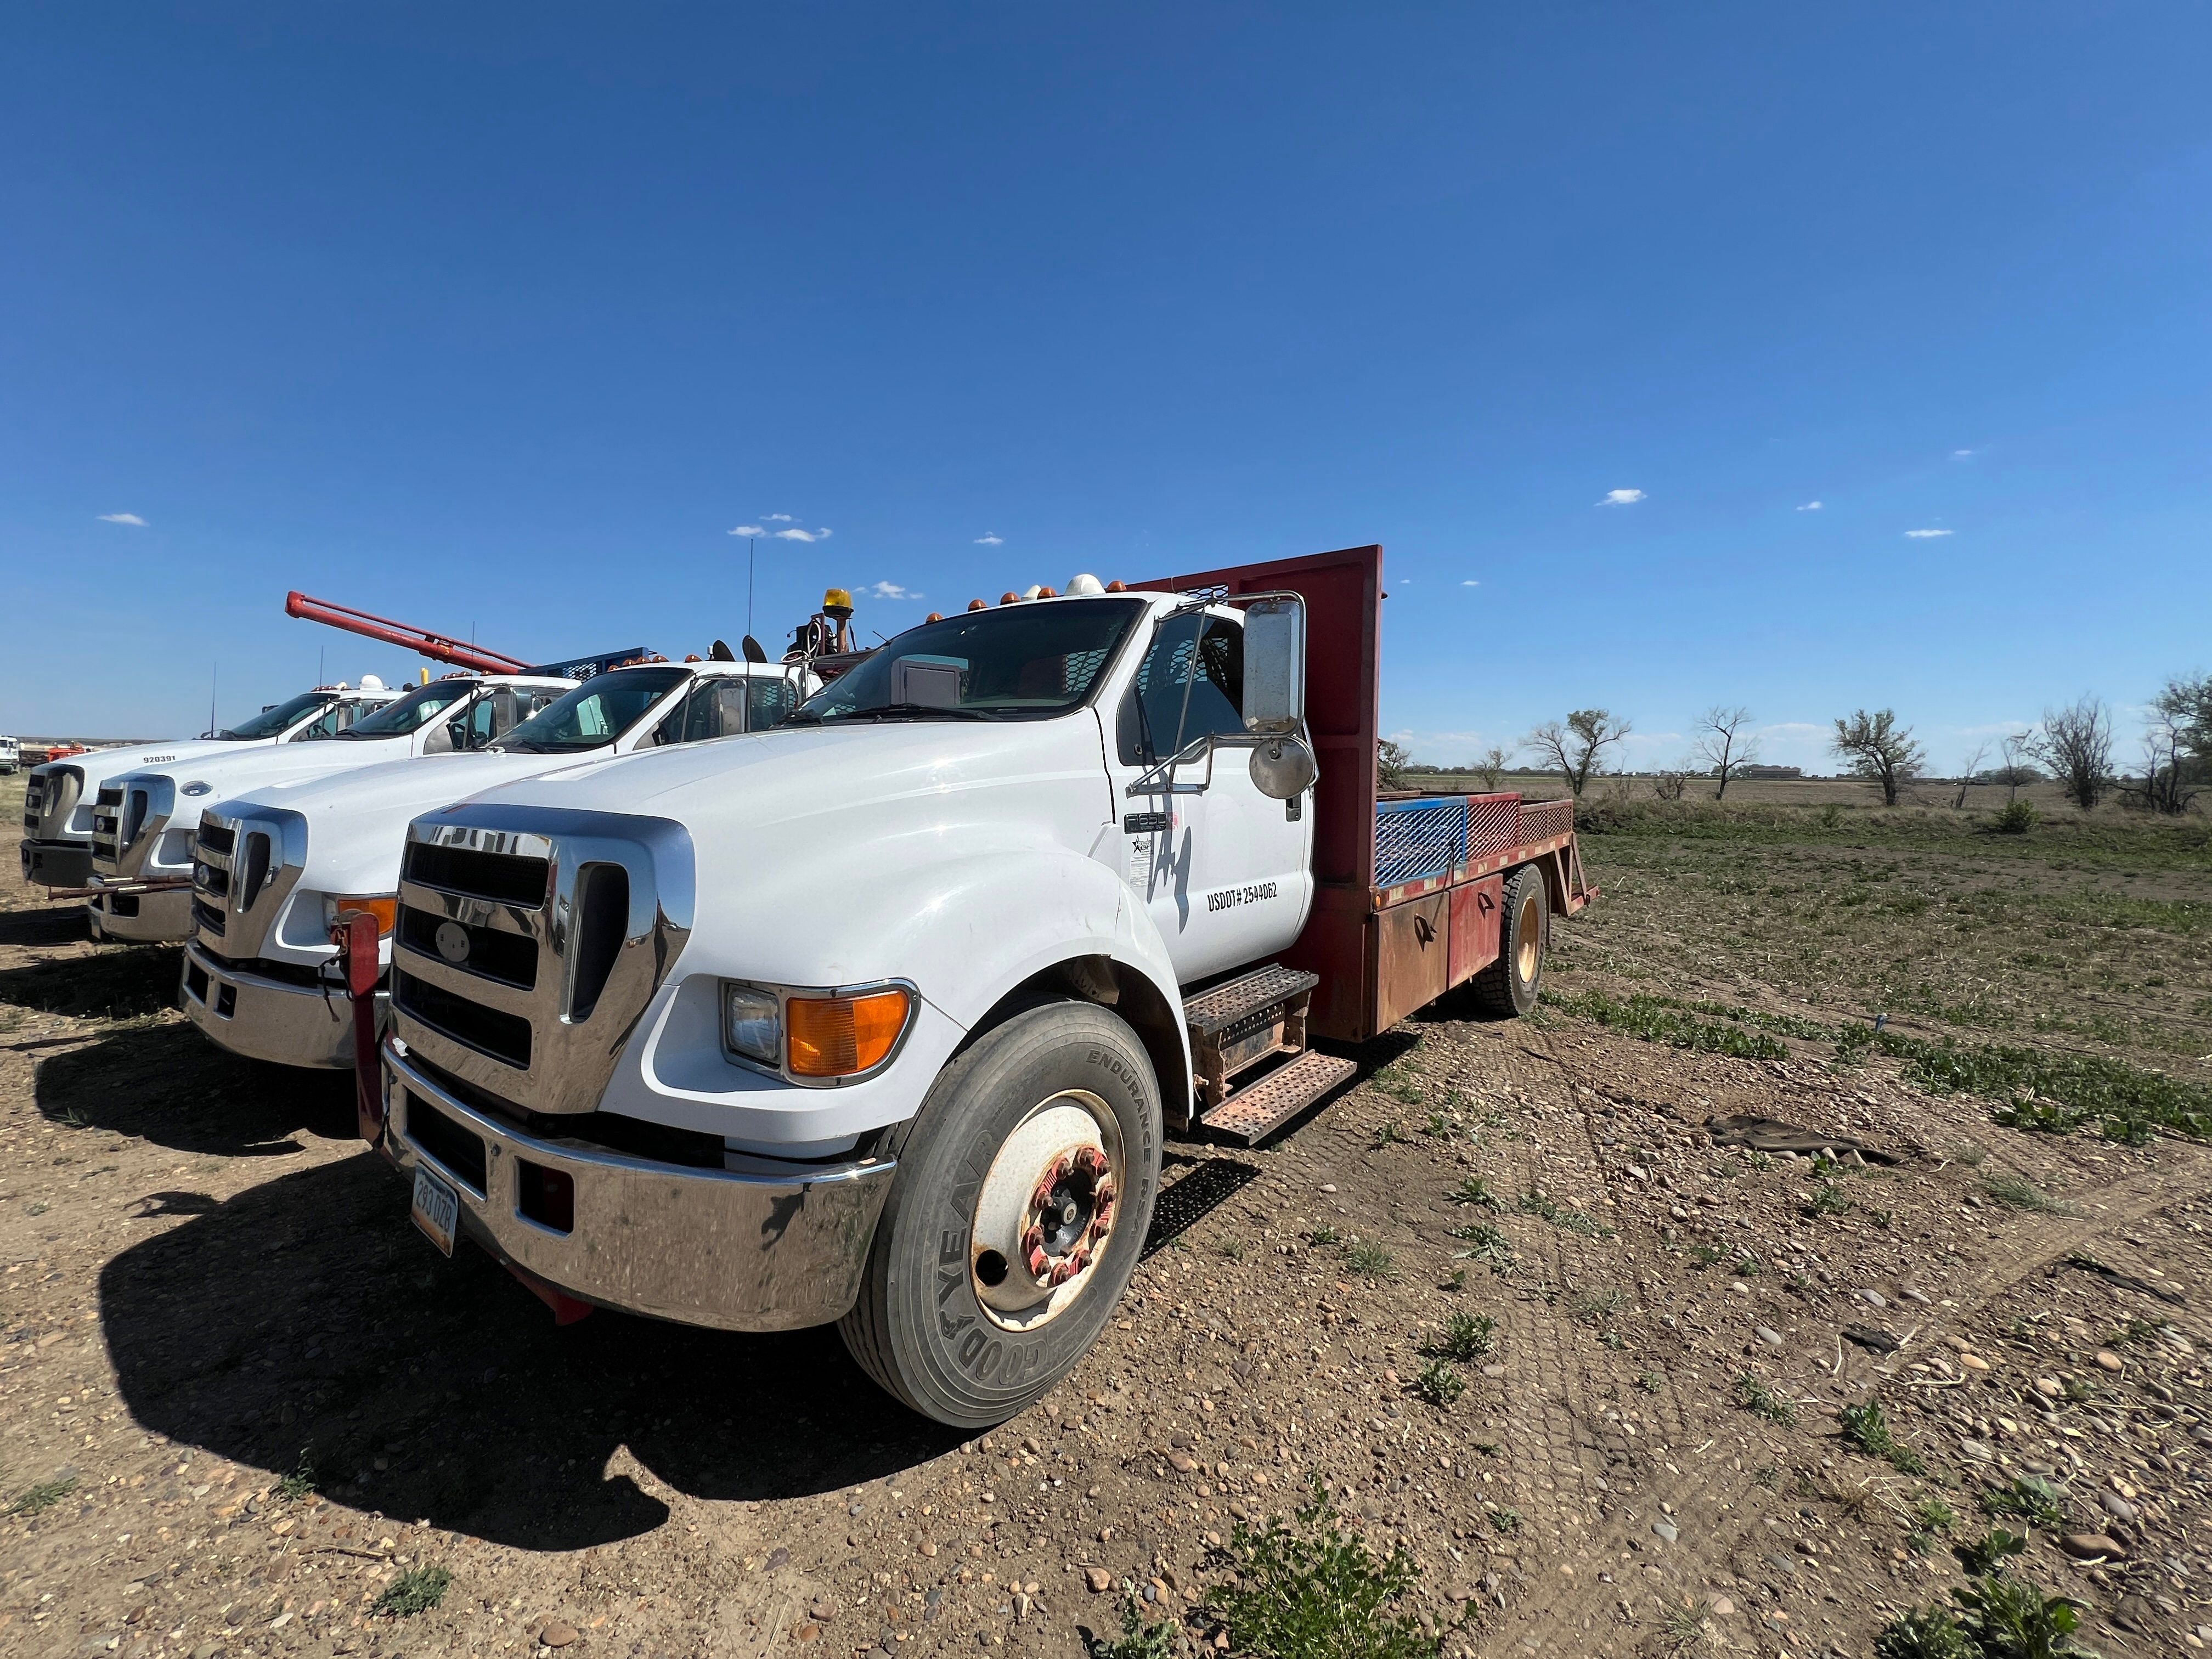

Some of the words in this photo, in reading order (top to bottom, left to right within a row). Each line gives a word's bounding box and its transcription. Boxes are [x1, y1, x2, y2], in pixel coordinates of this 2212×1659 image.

[143, 755, 176, 764] 920391
[1207, 888, 1242, 912] USDOT#
[1243, 882, 1277, 905] 2544062
[1086, 1049, 1151, 1164] ENDURANCE
[416, 1180, 433, 1216] 293
[938, 1130, 1048, 1386] GOODYEAR
